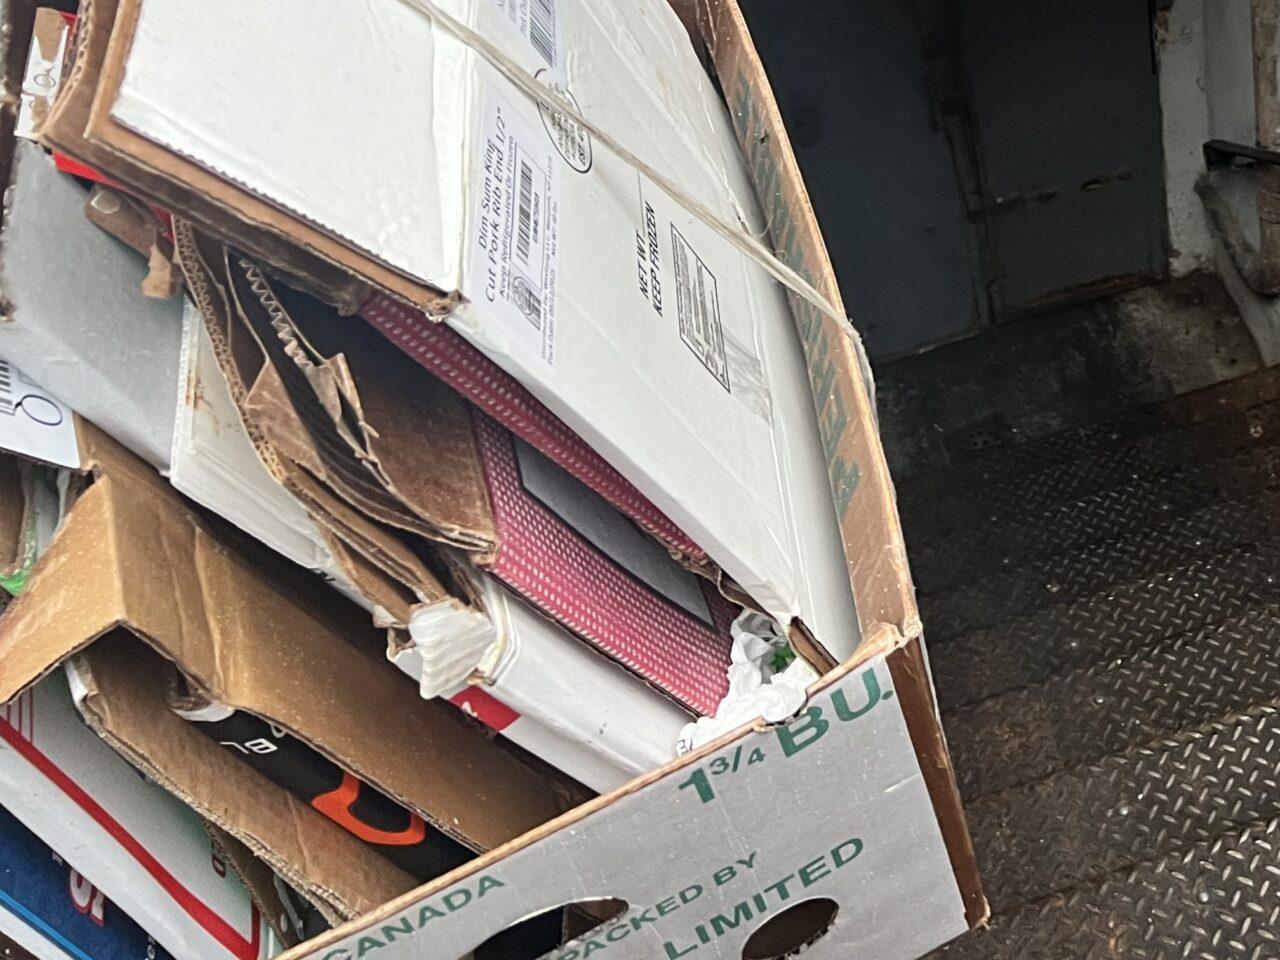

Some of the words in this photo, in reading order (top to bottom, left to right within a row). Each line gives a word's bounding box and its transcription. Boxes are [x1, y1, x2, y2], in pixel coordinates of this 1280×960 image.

[483, 139, 496, 173] King
[494, 151, 504, 185] End
[481, 177, 491, 213] Sum
[492, 187, 503, 217] Rib
[478, 215, 488, 250] Dim
[487, 217, 501, 265] Pork
[635, 228, 646, 262] WT
[644, 199, 660, 270] FROZEN
[485, 266, 497, 303] Cut
[637, 261, 650, 301] NET
[649, 269, 663, 318] KEEP
[775, 667, 894, 759] BU.
[322, 875, 506, 960] CANADA
[560, 883, 704, 960] PACKED
[712, 850, 758, 887] BY
[662, 837, 864, 960] LIMITED
